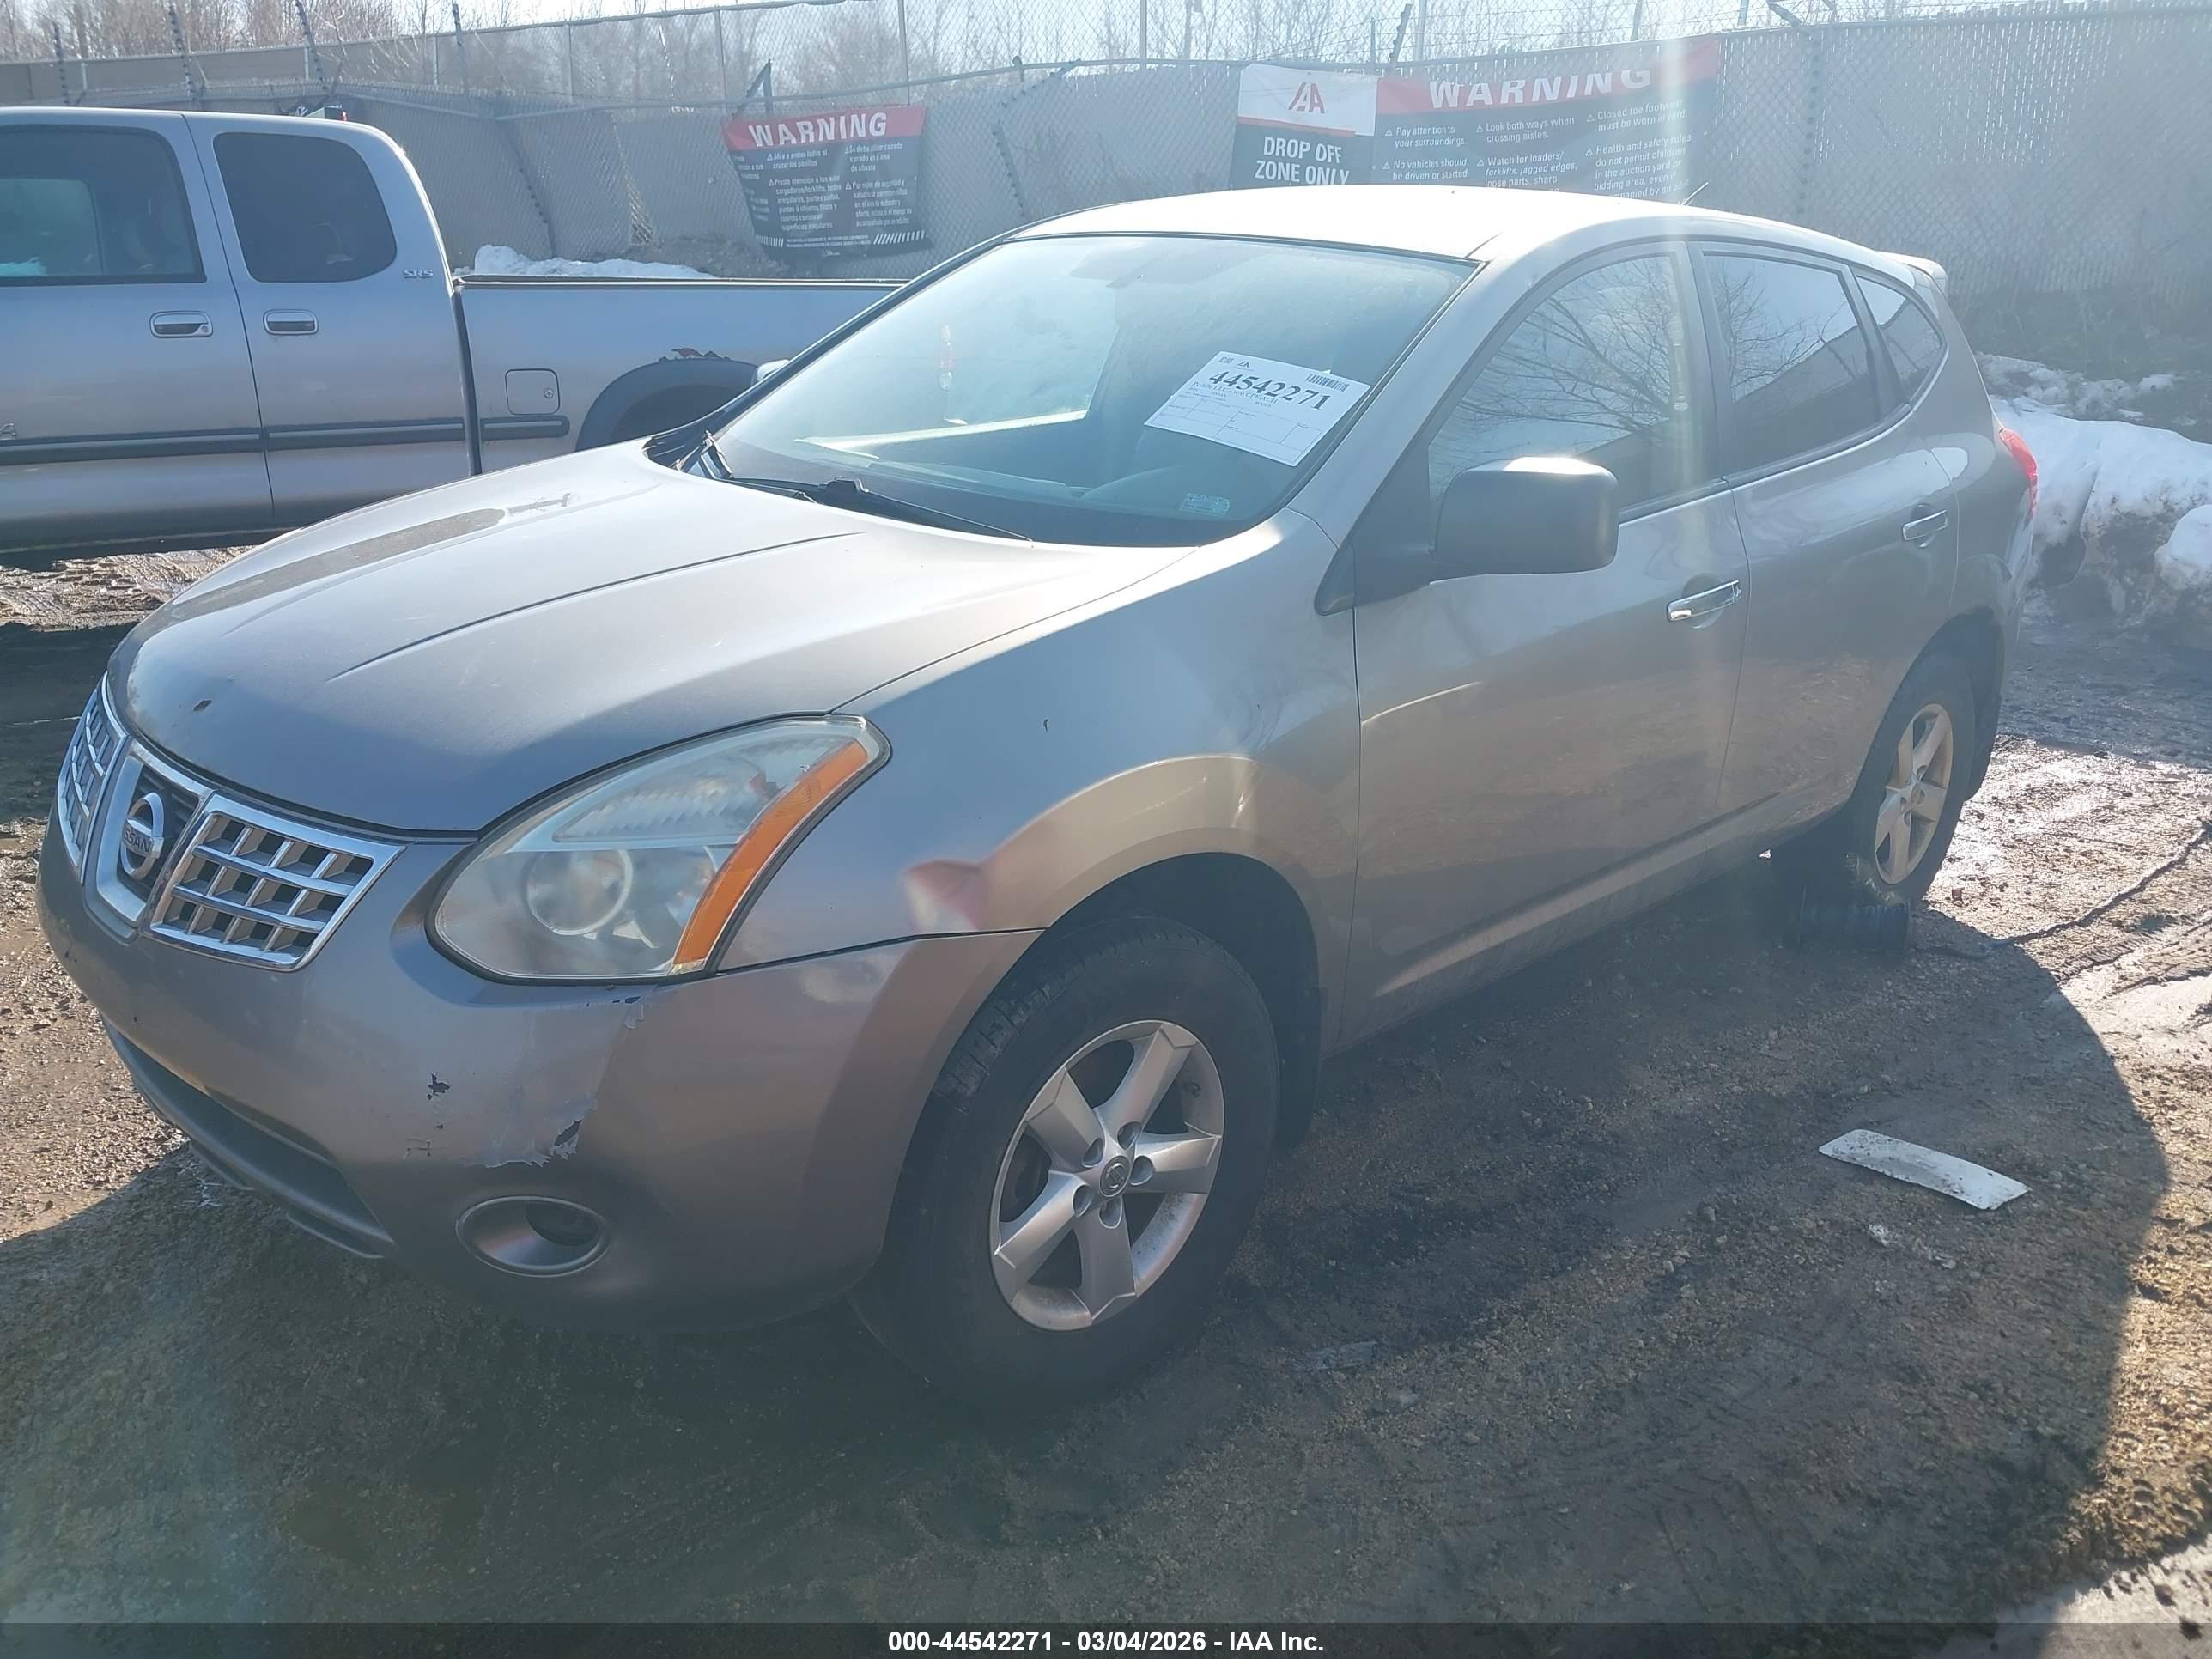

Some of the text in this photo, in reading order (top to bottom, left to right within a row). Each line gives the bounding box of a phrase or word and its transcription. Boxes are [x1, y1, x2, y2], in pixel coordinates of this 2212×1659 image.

[1429, 69, 1650, 109] WARNING
[1597, 107, 1627, 120] Closed
[1630, 106, 1644, 115] toe
[748, 112, 887, 148] WARNING
[1486, 116, 1575, 132] Look both ways when
[1598, 122, 1619, 131] must
[1620, 119, 1632, 128] be
[1633, 117, 1656, 126] worn
[1657, 113, 1666, 123] in
[1396, 126, 1411, 137] Pay
[1413, 125, 1446, 136] attention
[1486, 131, 1549, 143] crossing aisles.
[1263, 137, 1342, 164] DROP OFF
[1395, 137, 1468, 149] your surroundings.
[1596, 133, 1692, 155] Health and safety rules
[1394, 157, 1468, 169] No vehicles should
[1487, 151, 1564, 166] Watch for loaders/
[1595, 147, 1686, 167] do not permit children
[1255, 160, 1350, 185] ZONE ONLY
[1393, 172, 1403, 180] be
[1405, 171, 1430, 180] driven
[1442, 168, 1468, 179] started
[1486, 161, 1577, 176] forklifts, jagged edges,
[1595, 170, 1602, 179] in
[1605, 168, 1618, 178] the
[1620, 165, 1650, 177] auction
[1652, 160, 1671, 172] yard
[1485, 175, 1558, 188] loose parts, sharp
[1594, 170, 1677, 191] bidding area, even if
[1650, 187, 1659, 197] by
[1662, 185, 1671, 194] an
[1208, 371, 1331, 410] 44542271
